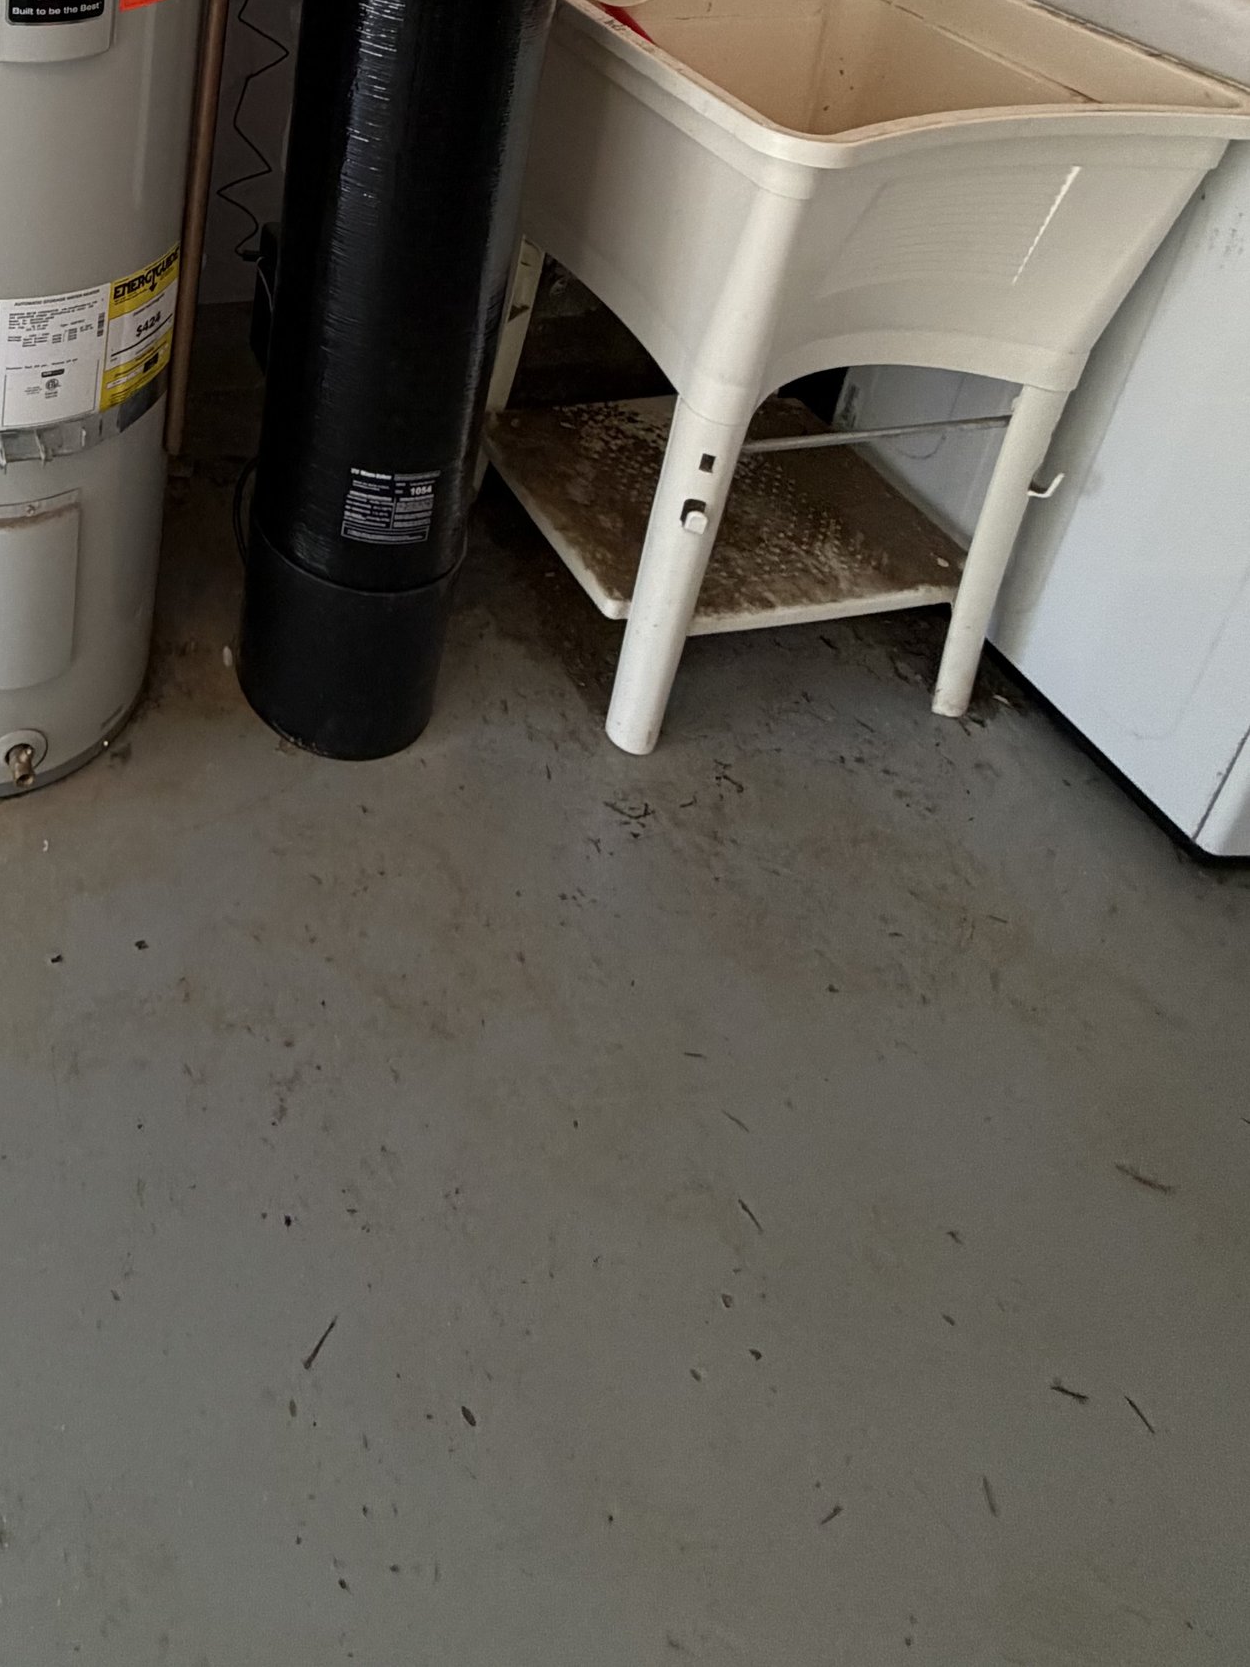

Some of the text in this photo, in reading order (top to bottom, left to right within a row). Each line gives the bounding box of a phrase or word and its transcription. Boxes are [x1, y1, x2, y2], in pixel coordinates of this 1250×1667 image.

[12, 3, 100, 16] Built to be the Best
